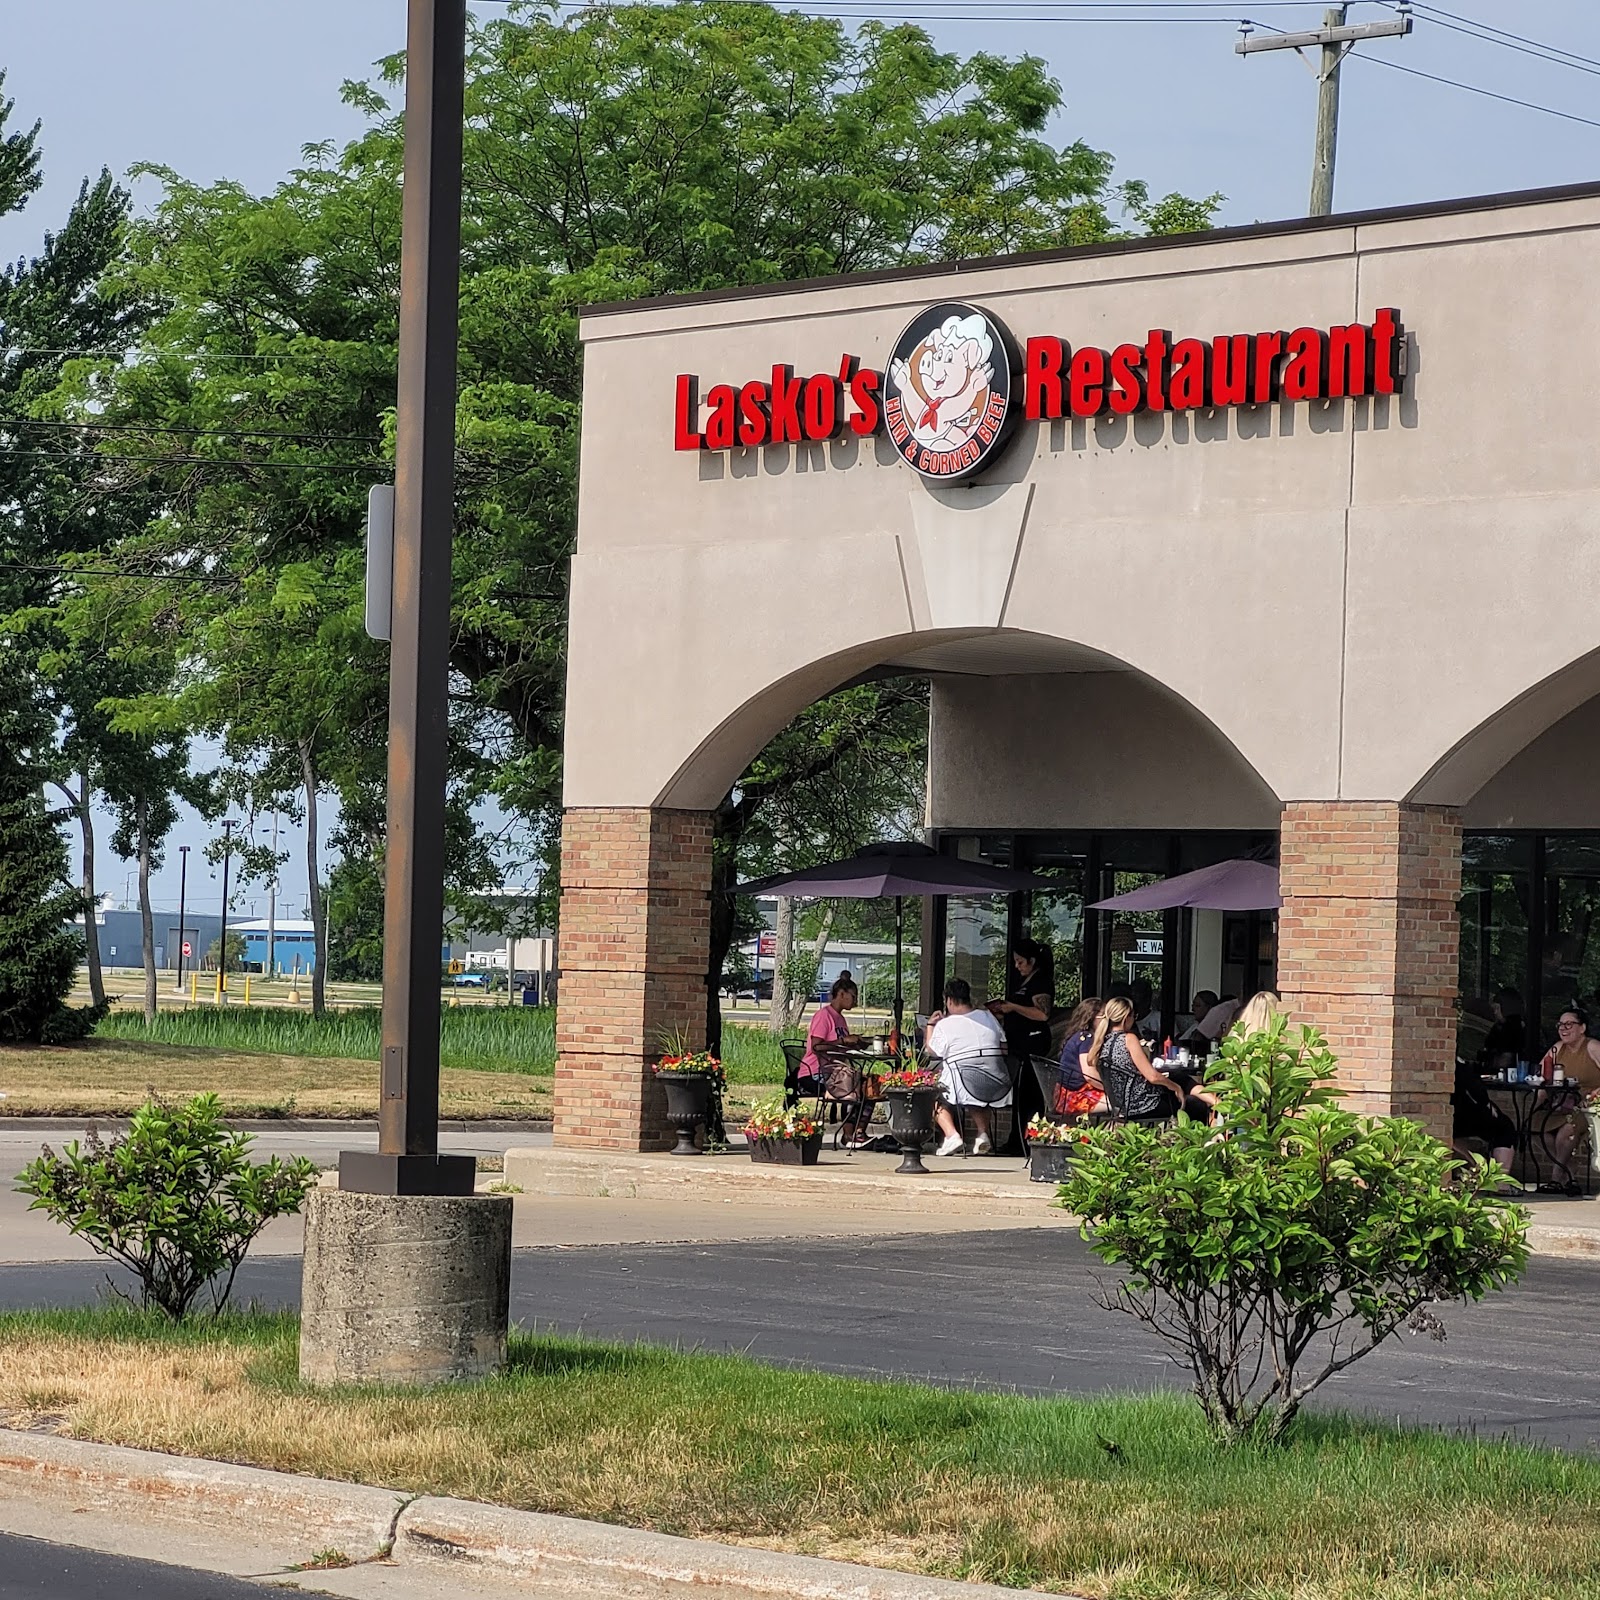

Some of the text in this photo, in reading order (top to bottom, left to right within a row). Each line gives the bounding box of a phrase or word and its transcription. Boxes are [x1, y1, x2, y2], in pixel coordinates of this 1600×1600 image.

[675, 307, 1395, 451] Lasko's Restaurant
[886, 391, 1006, 474] HAM & CORNED BEEF
